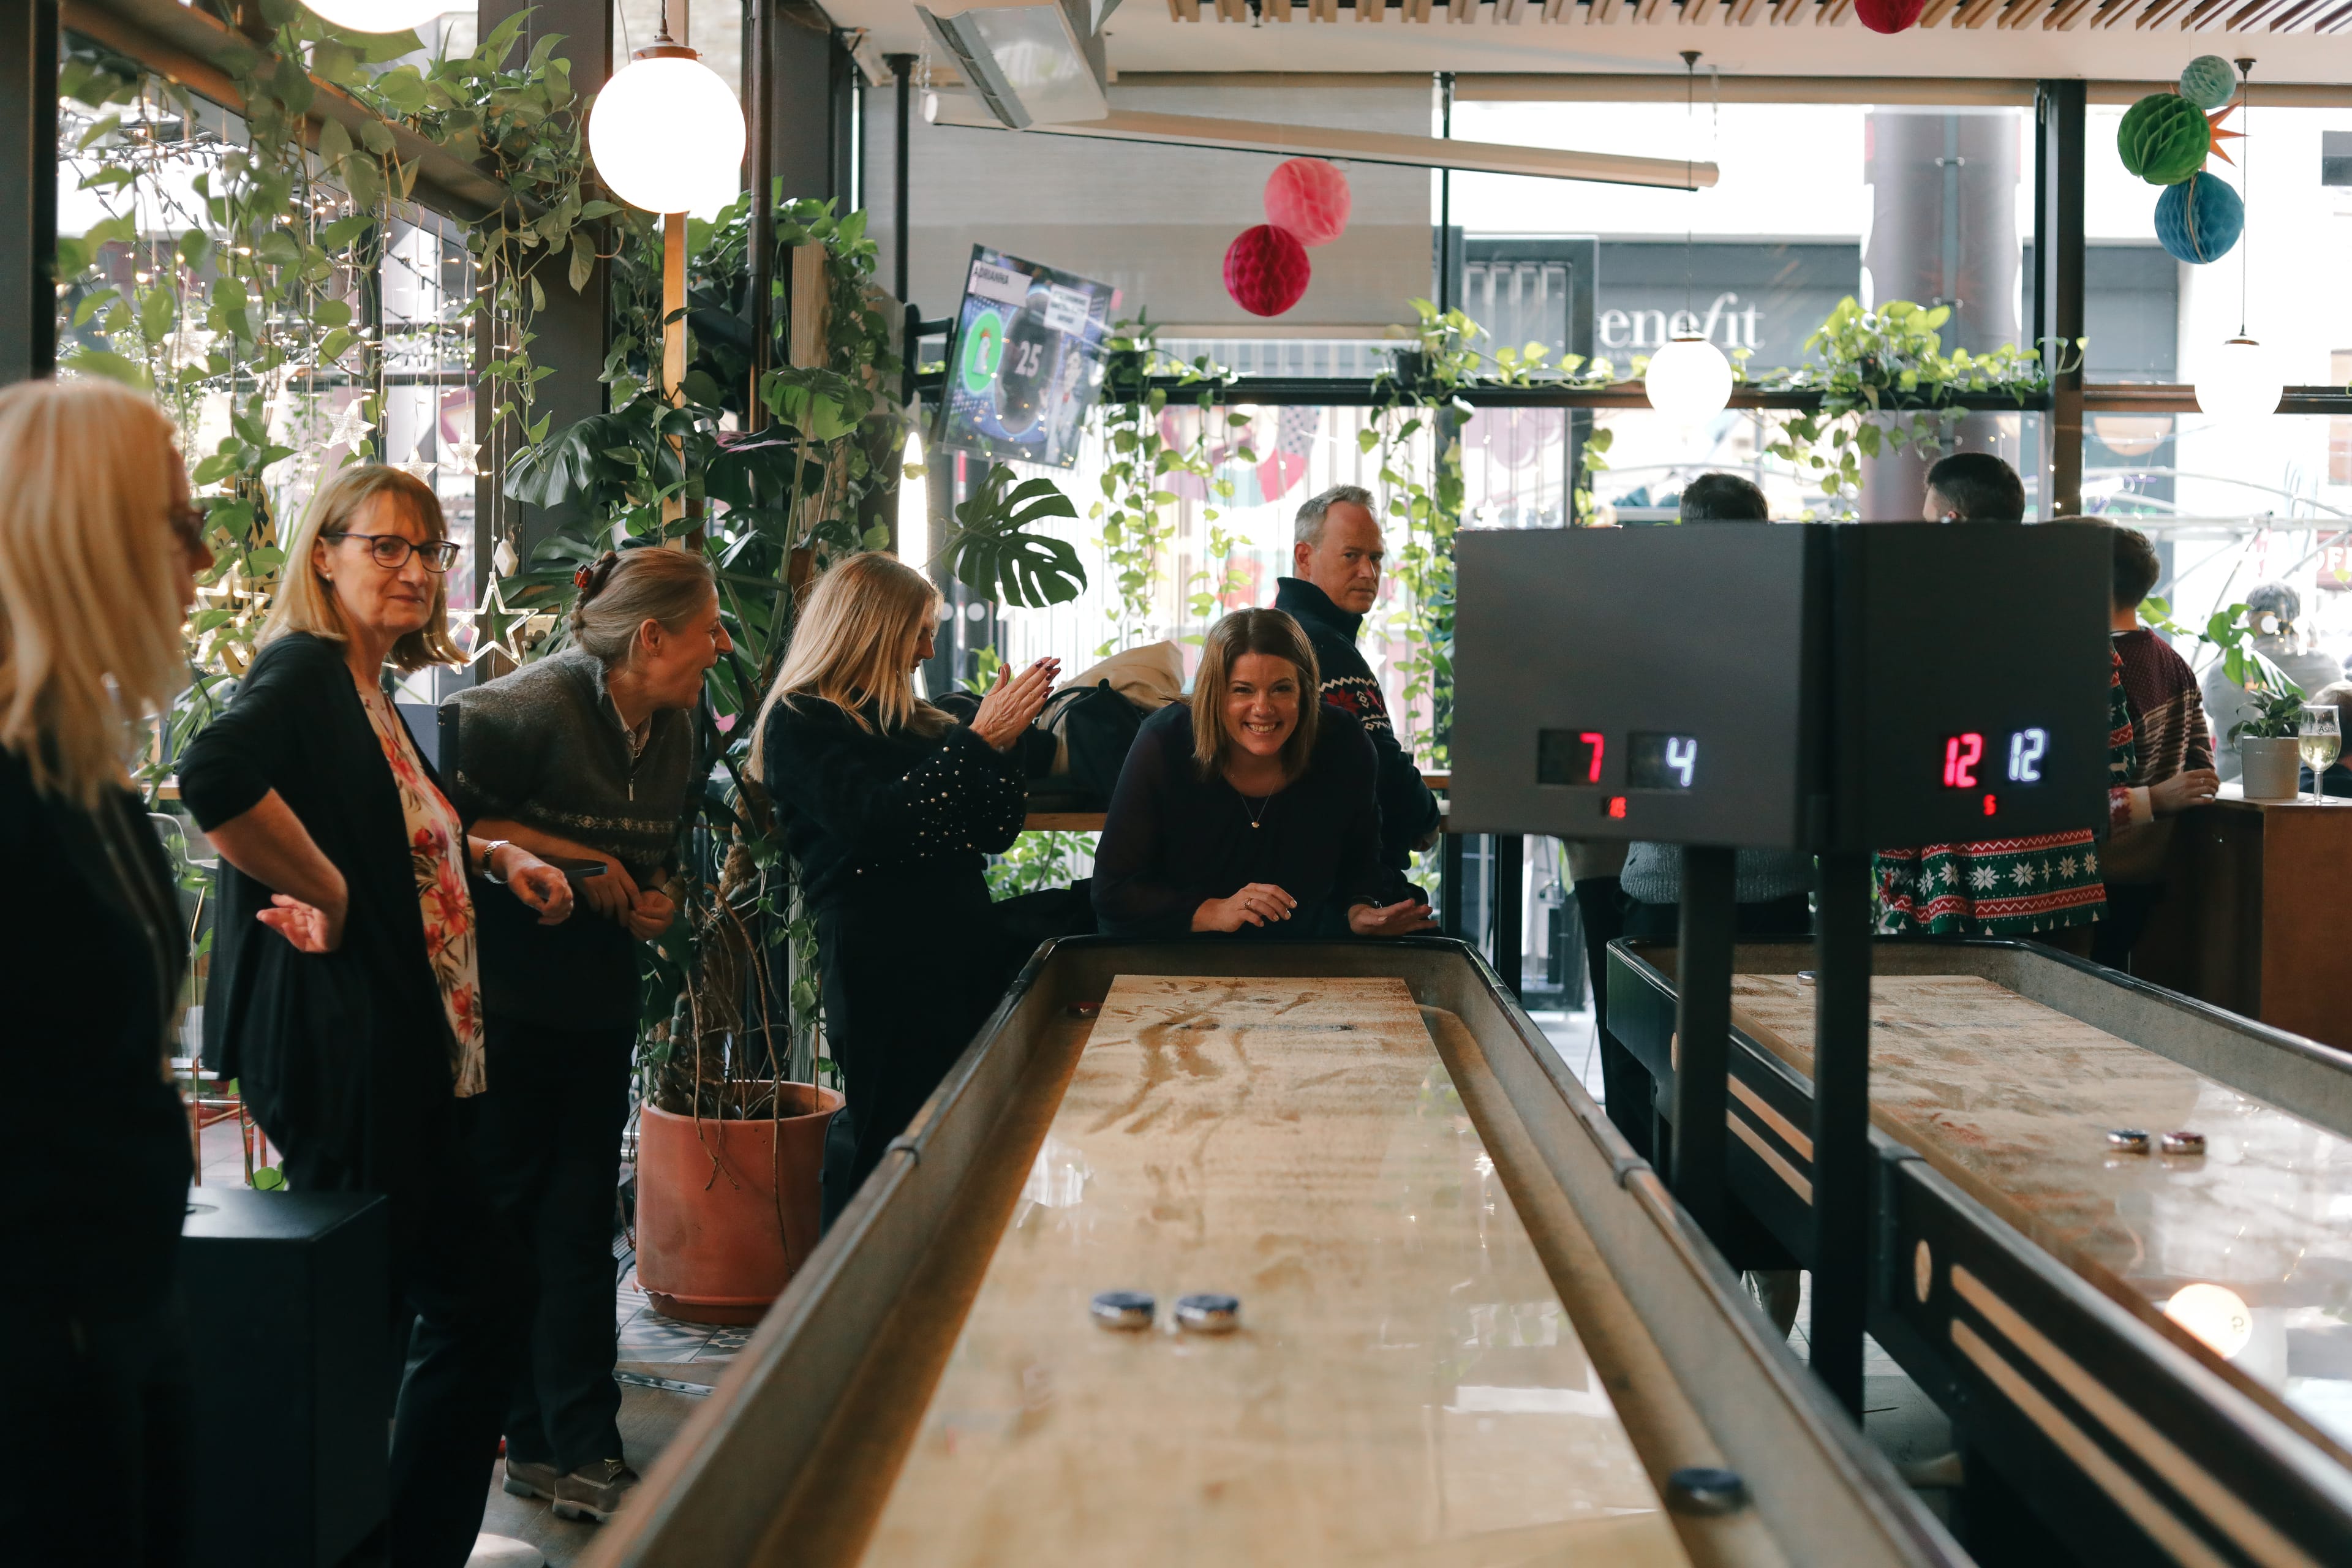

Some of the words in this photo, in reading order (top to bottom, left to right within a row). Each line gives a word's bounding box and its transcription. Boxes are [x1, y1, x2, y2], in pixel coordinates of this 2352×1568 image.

[1597, 292, 1766, 349] enefit
[1014, 341, 1043, 377] 25
[1580, 733, 1604, 783] 7
[1666, 737, 1697, 787] 4
[1944, 733, 1982, 787] 12
[2009, 728, 2045, 782] 12
